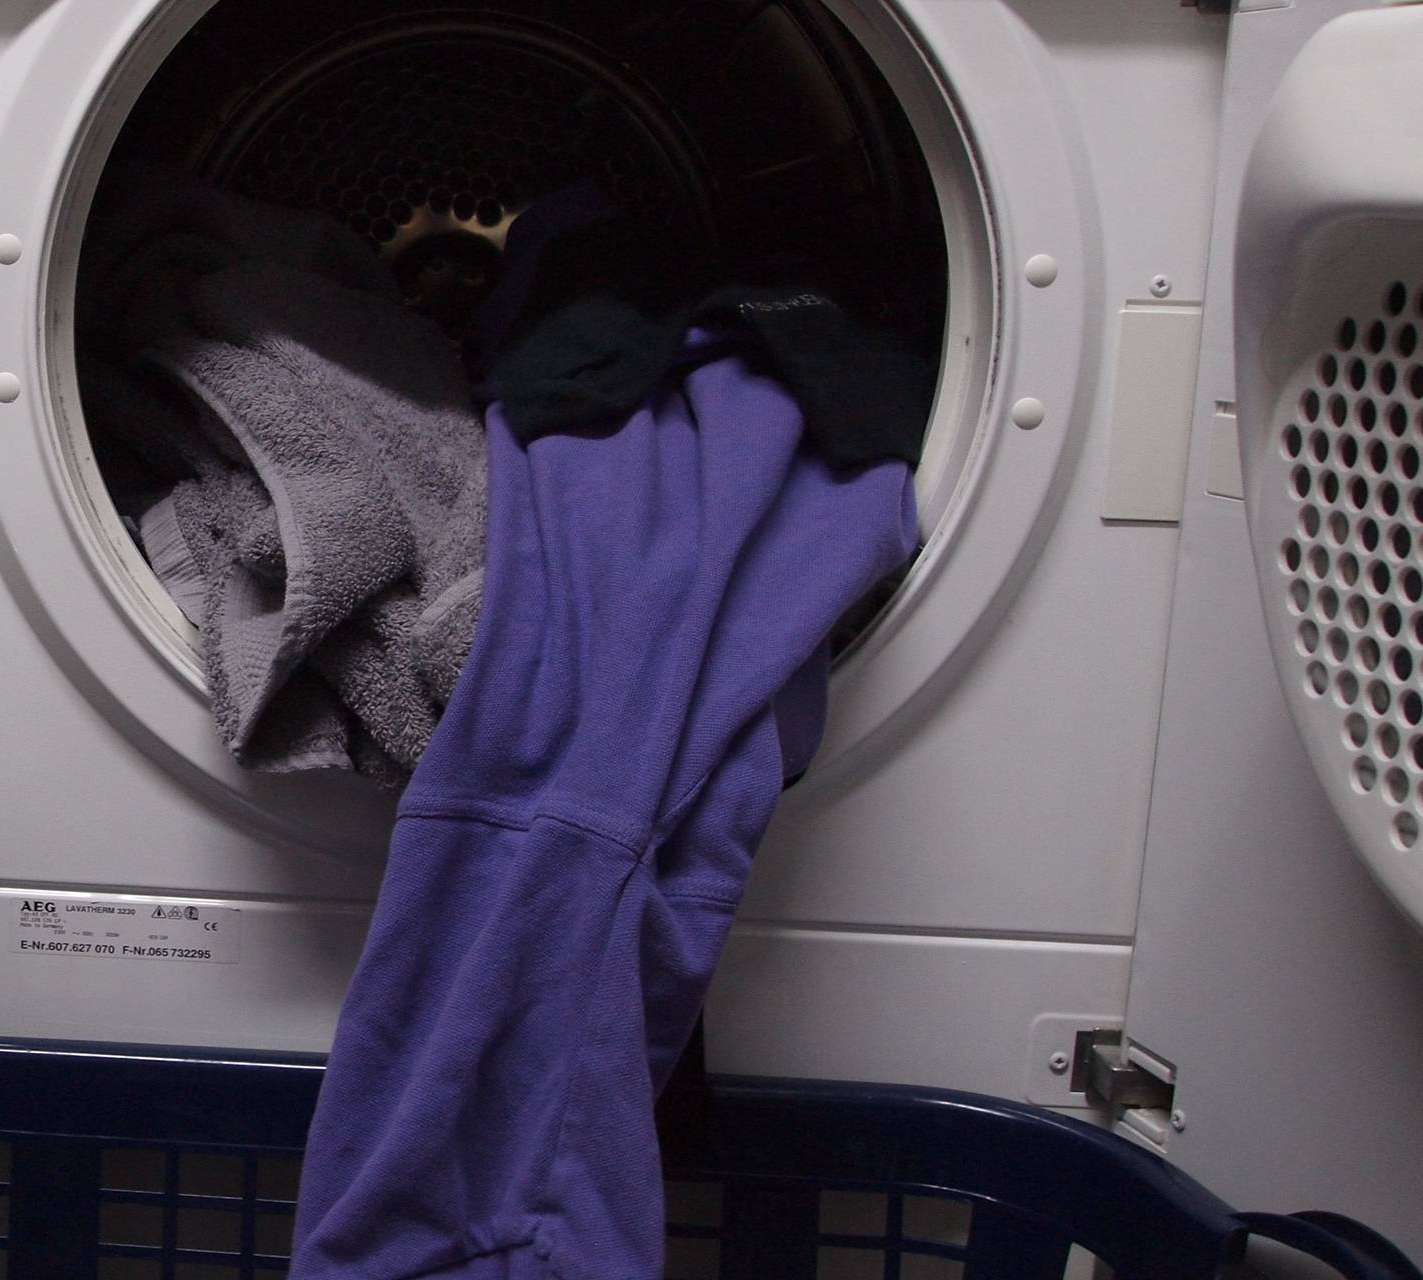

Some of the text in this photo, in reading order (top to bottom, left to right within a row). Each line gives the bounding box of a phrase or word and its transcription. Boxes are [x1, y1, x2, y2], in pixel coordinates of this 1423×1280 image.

[21, 901, 56, 912] AEG
[66, 905, 114, 914] LAVATHERM
[21, 940, 211, 959] E-Nr.607.627 070 F-Nr.065 732295
